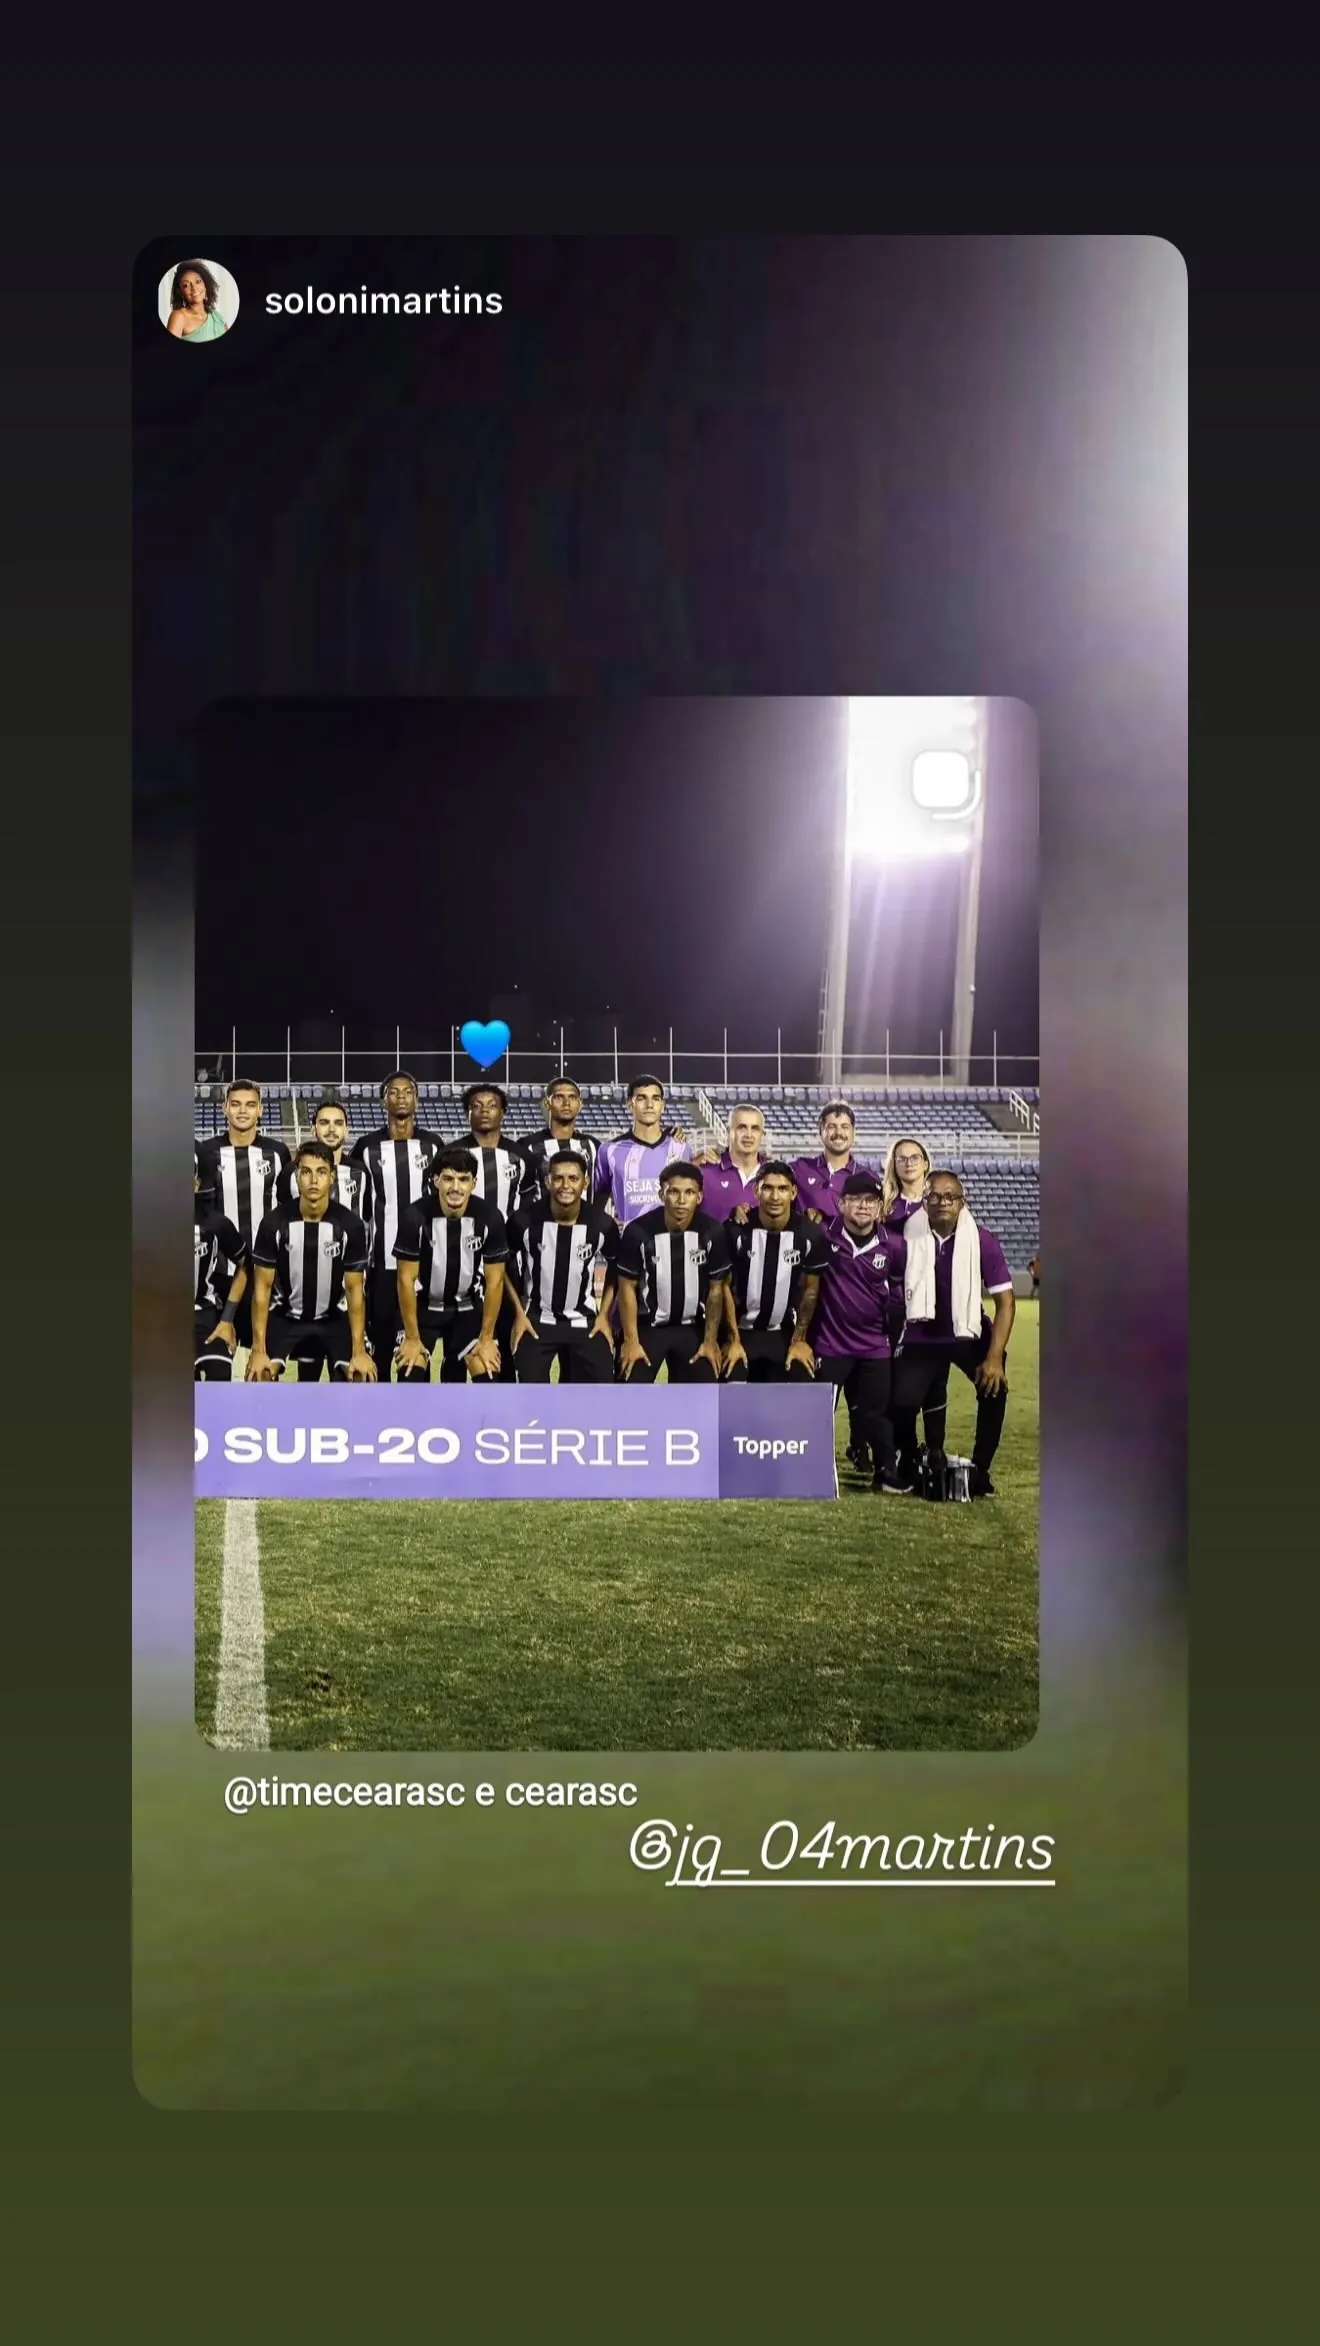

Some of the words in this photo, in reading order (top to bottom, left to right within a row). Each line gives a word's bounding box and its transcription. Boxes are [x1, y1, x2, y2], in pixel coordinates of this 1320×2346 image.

[626, 1179, 653, 1193] SEJA
[224, 1427, 460, 1464] SUB-20
[474, 1419, 649, 1466] SÉRIE
[665, 1428, 700, 1465] B
[733, 1436, 809, 1459] Topper
